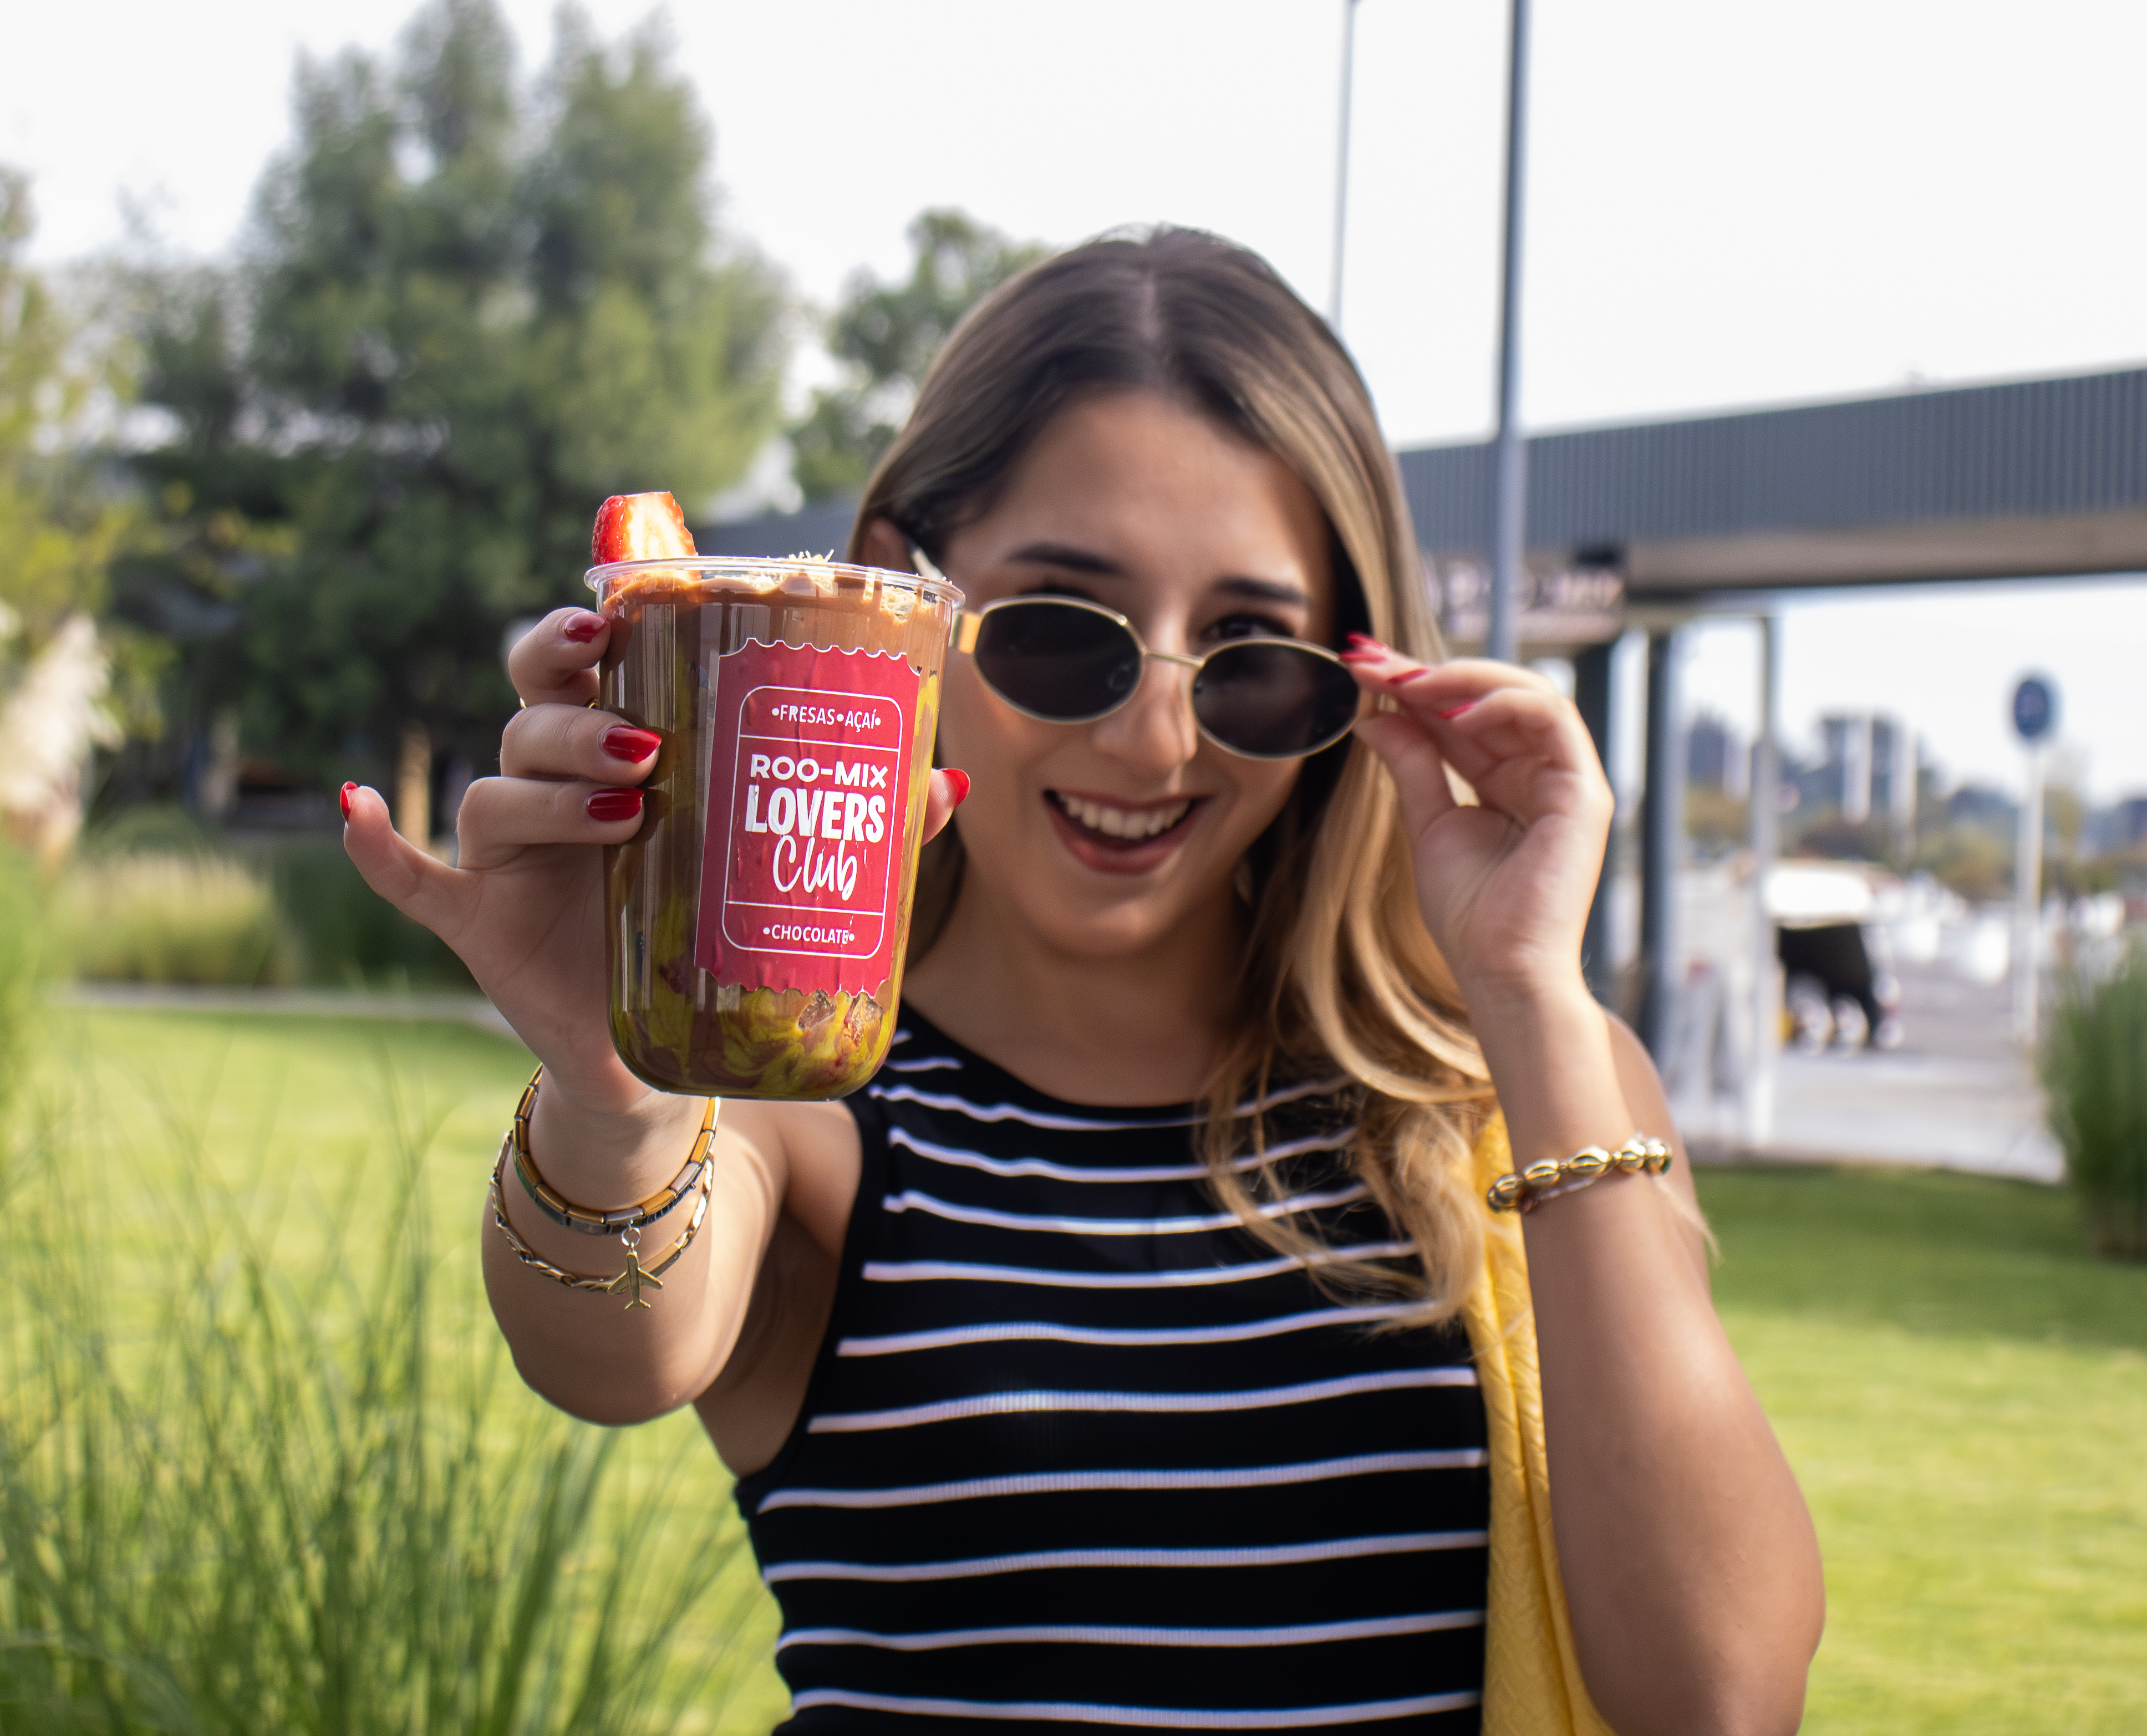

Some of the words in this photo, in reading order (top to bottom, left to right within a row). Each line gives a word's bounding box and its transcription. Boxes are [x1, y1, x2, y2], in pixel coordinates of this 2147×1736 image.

[780, 704, 835, 725] FRESAS
[750, 754, 888, 789] ROO-MIX
[745, 785, 886, 843] LOVERS
[773, 834, 857, 900] Club
[771, 924, 849, 944] CHOCOLATE
